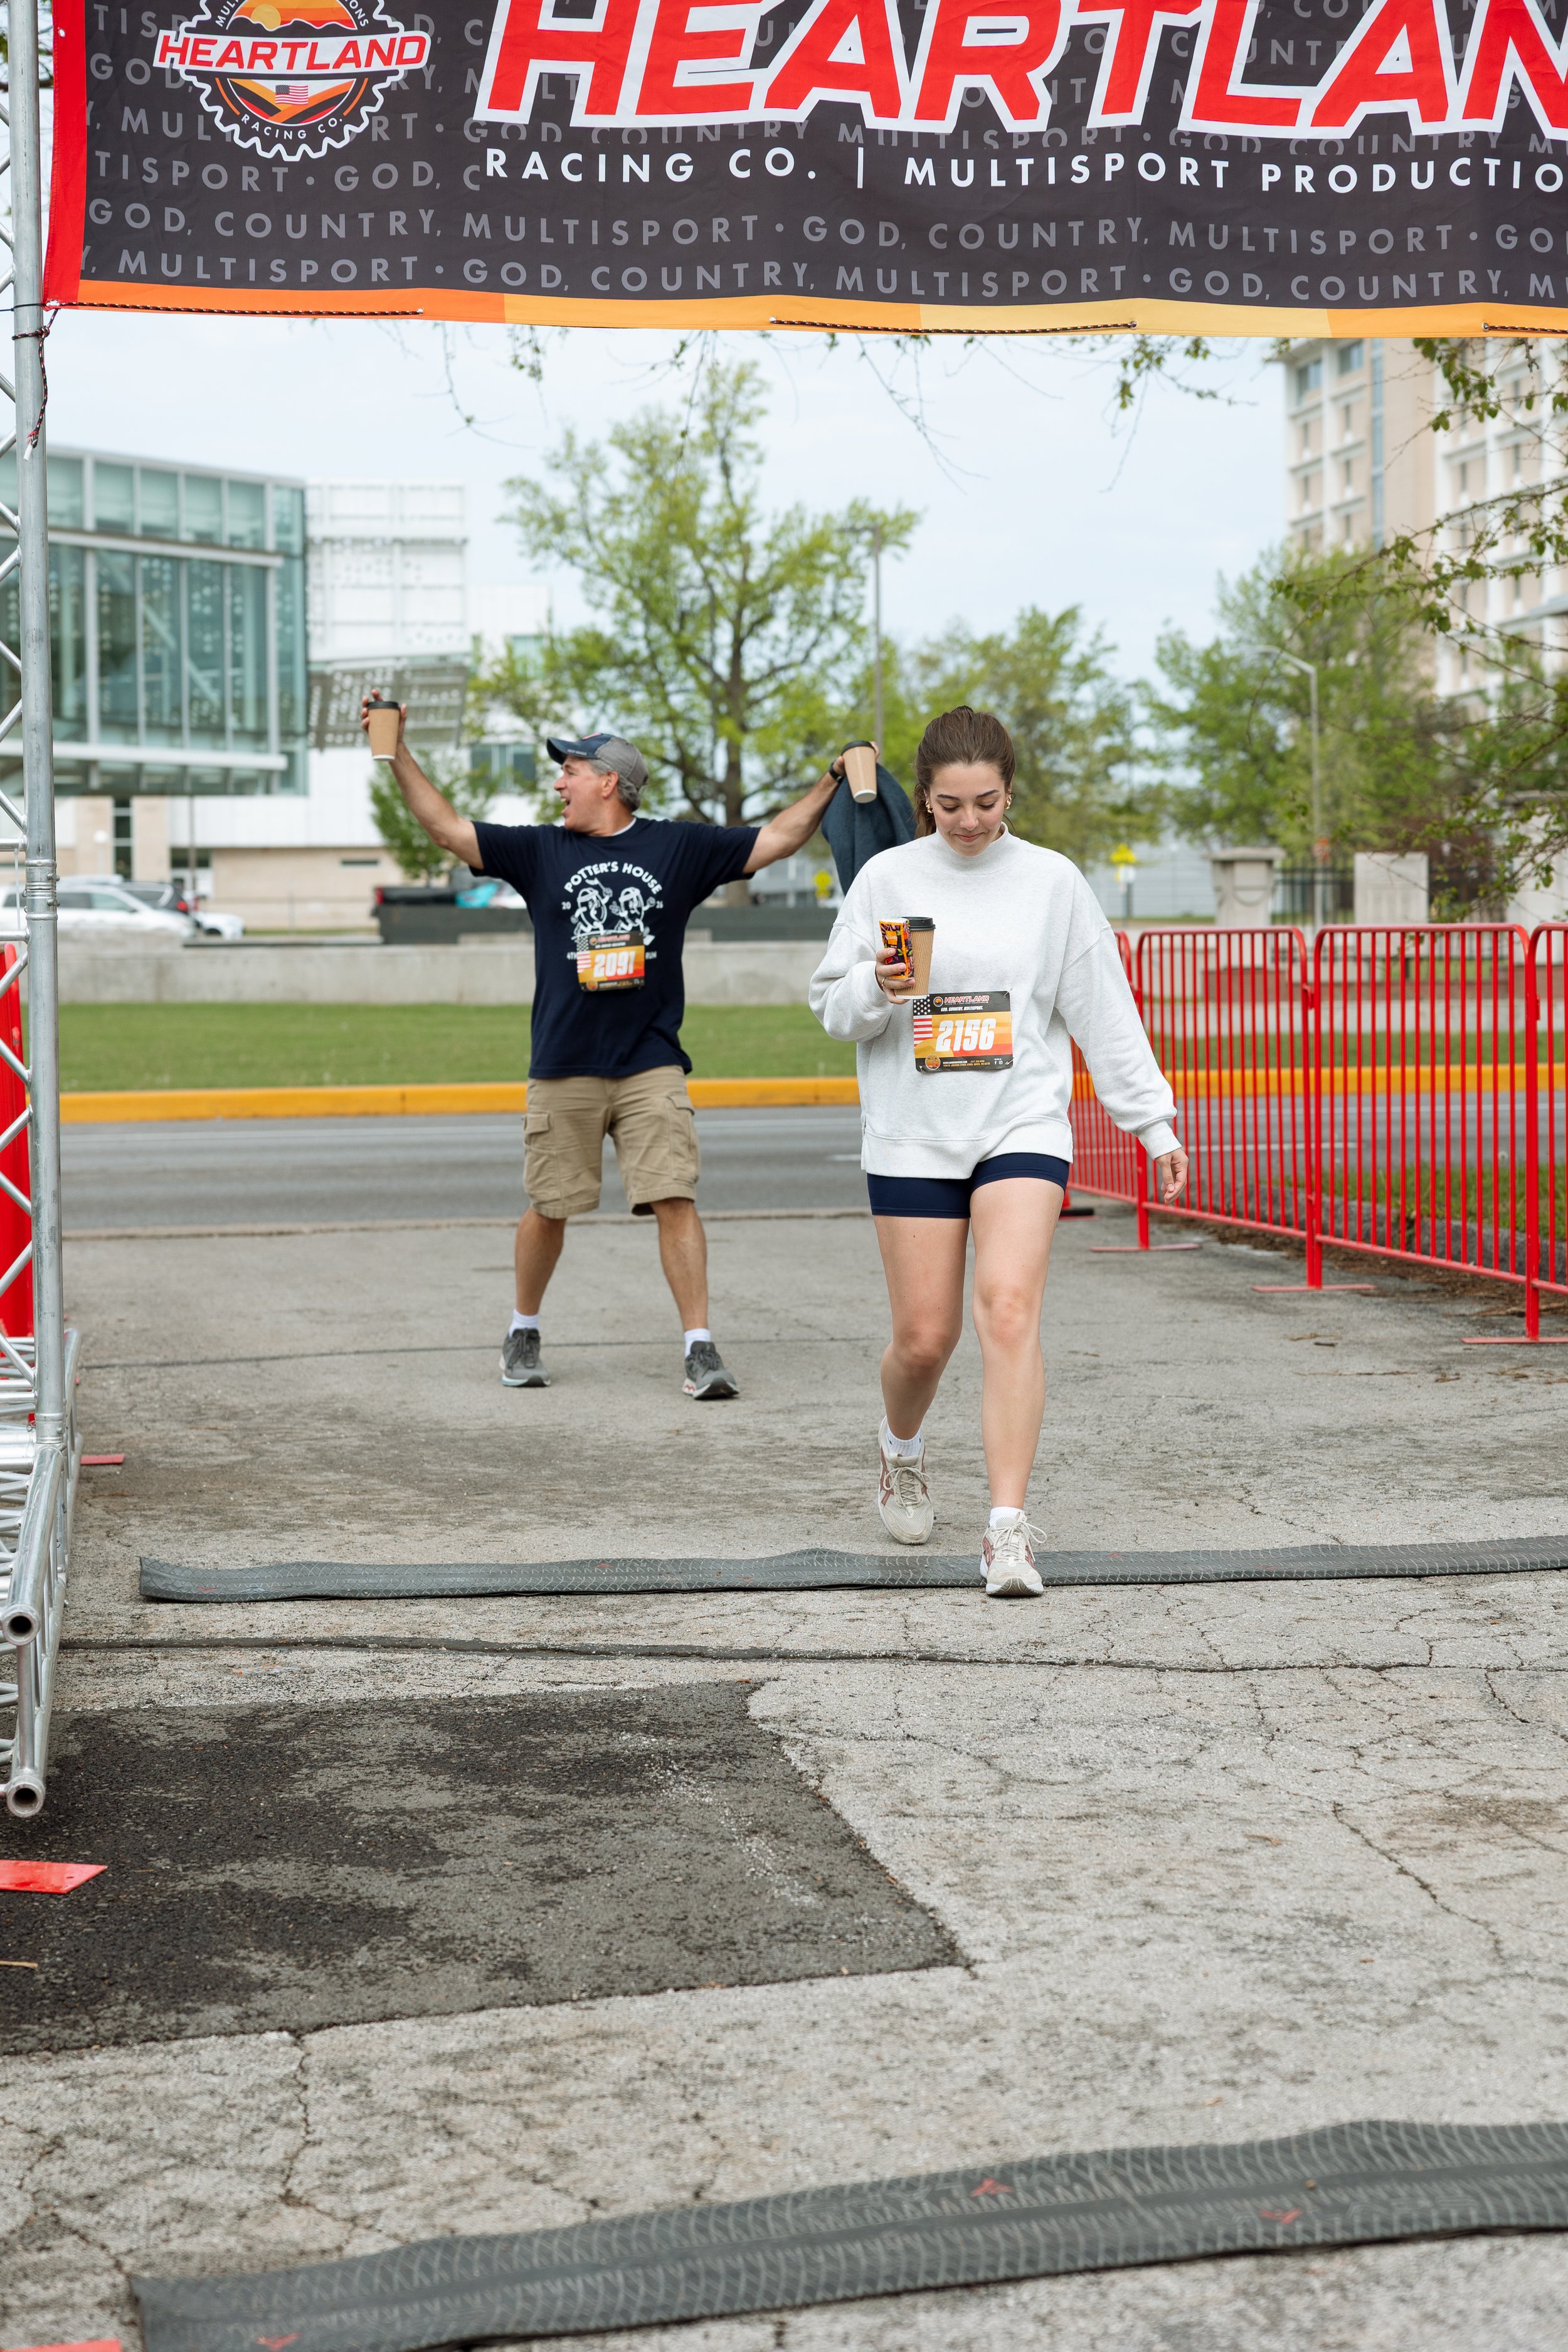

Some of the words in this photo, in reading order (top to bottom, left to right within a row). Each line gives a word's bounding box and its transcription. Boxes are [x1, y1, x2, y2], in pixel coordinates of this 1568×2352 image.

[157, 34, 427, 70] HEARTLAND
[240, 114, 307, 140] RACING
[317, 117, 342, 134] CO.
[334, 161, 441, 191] GOD,
[486, 148, 694, 183] RACING
[729, 147, 816, 179] CO.
[904, 152, 1229, 188] MULTISPORT
[1262, 157, 1563, 193] PRODUCTIO
[89, 198, 192, 236] GOD,
[215, 209, 441, 240] COUNTRY,
[463, 213, 758, 245] MULTISPORT
[803, 216, 906, 250] GOD,
[928, 217, 1148, 250] COUNTRY,
[1168, 221, 1452, 255] MULTISPORT
[1495, 224, 1568, 255] GO
[118, 250, 418, 283] MULTISPORT
[463, 259, 569, 292] GOD,
[591, 262, 815, 292] COUNTRY,
[835, 265, 1126, 298] MULTISPORT
[1168, 267, 1271, 301] GOD,
[1290, 269, 1509, 301] COUNTRY,
[564, 861, 619, 893] POTTER'S
[622, 862, 662, 895] HOUSE
[593, 950, 636, 978] 2091
[943, 995, 990, 1004] HEARTLAND
[935, 1018, 996, 1052] 2156
